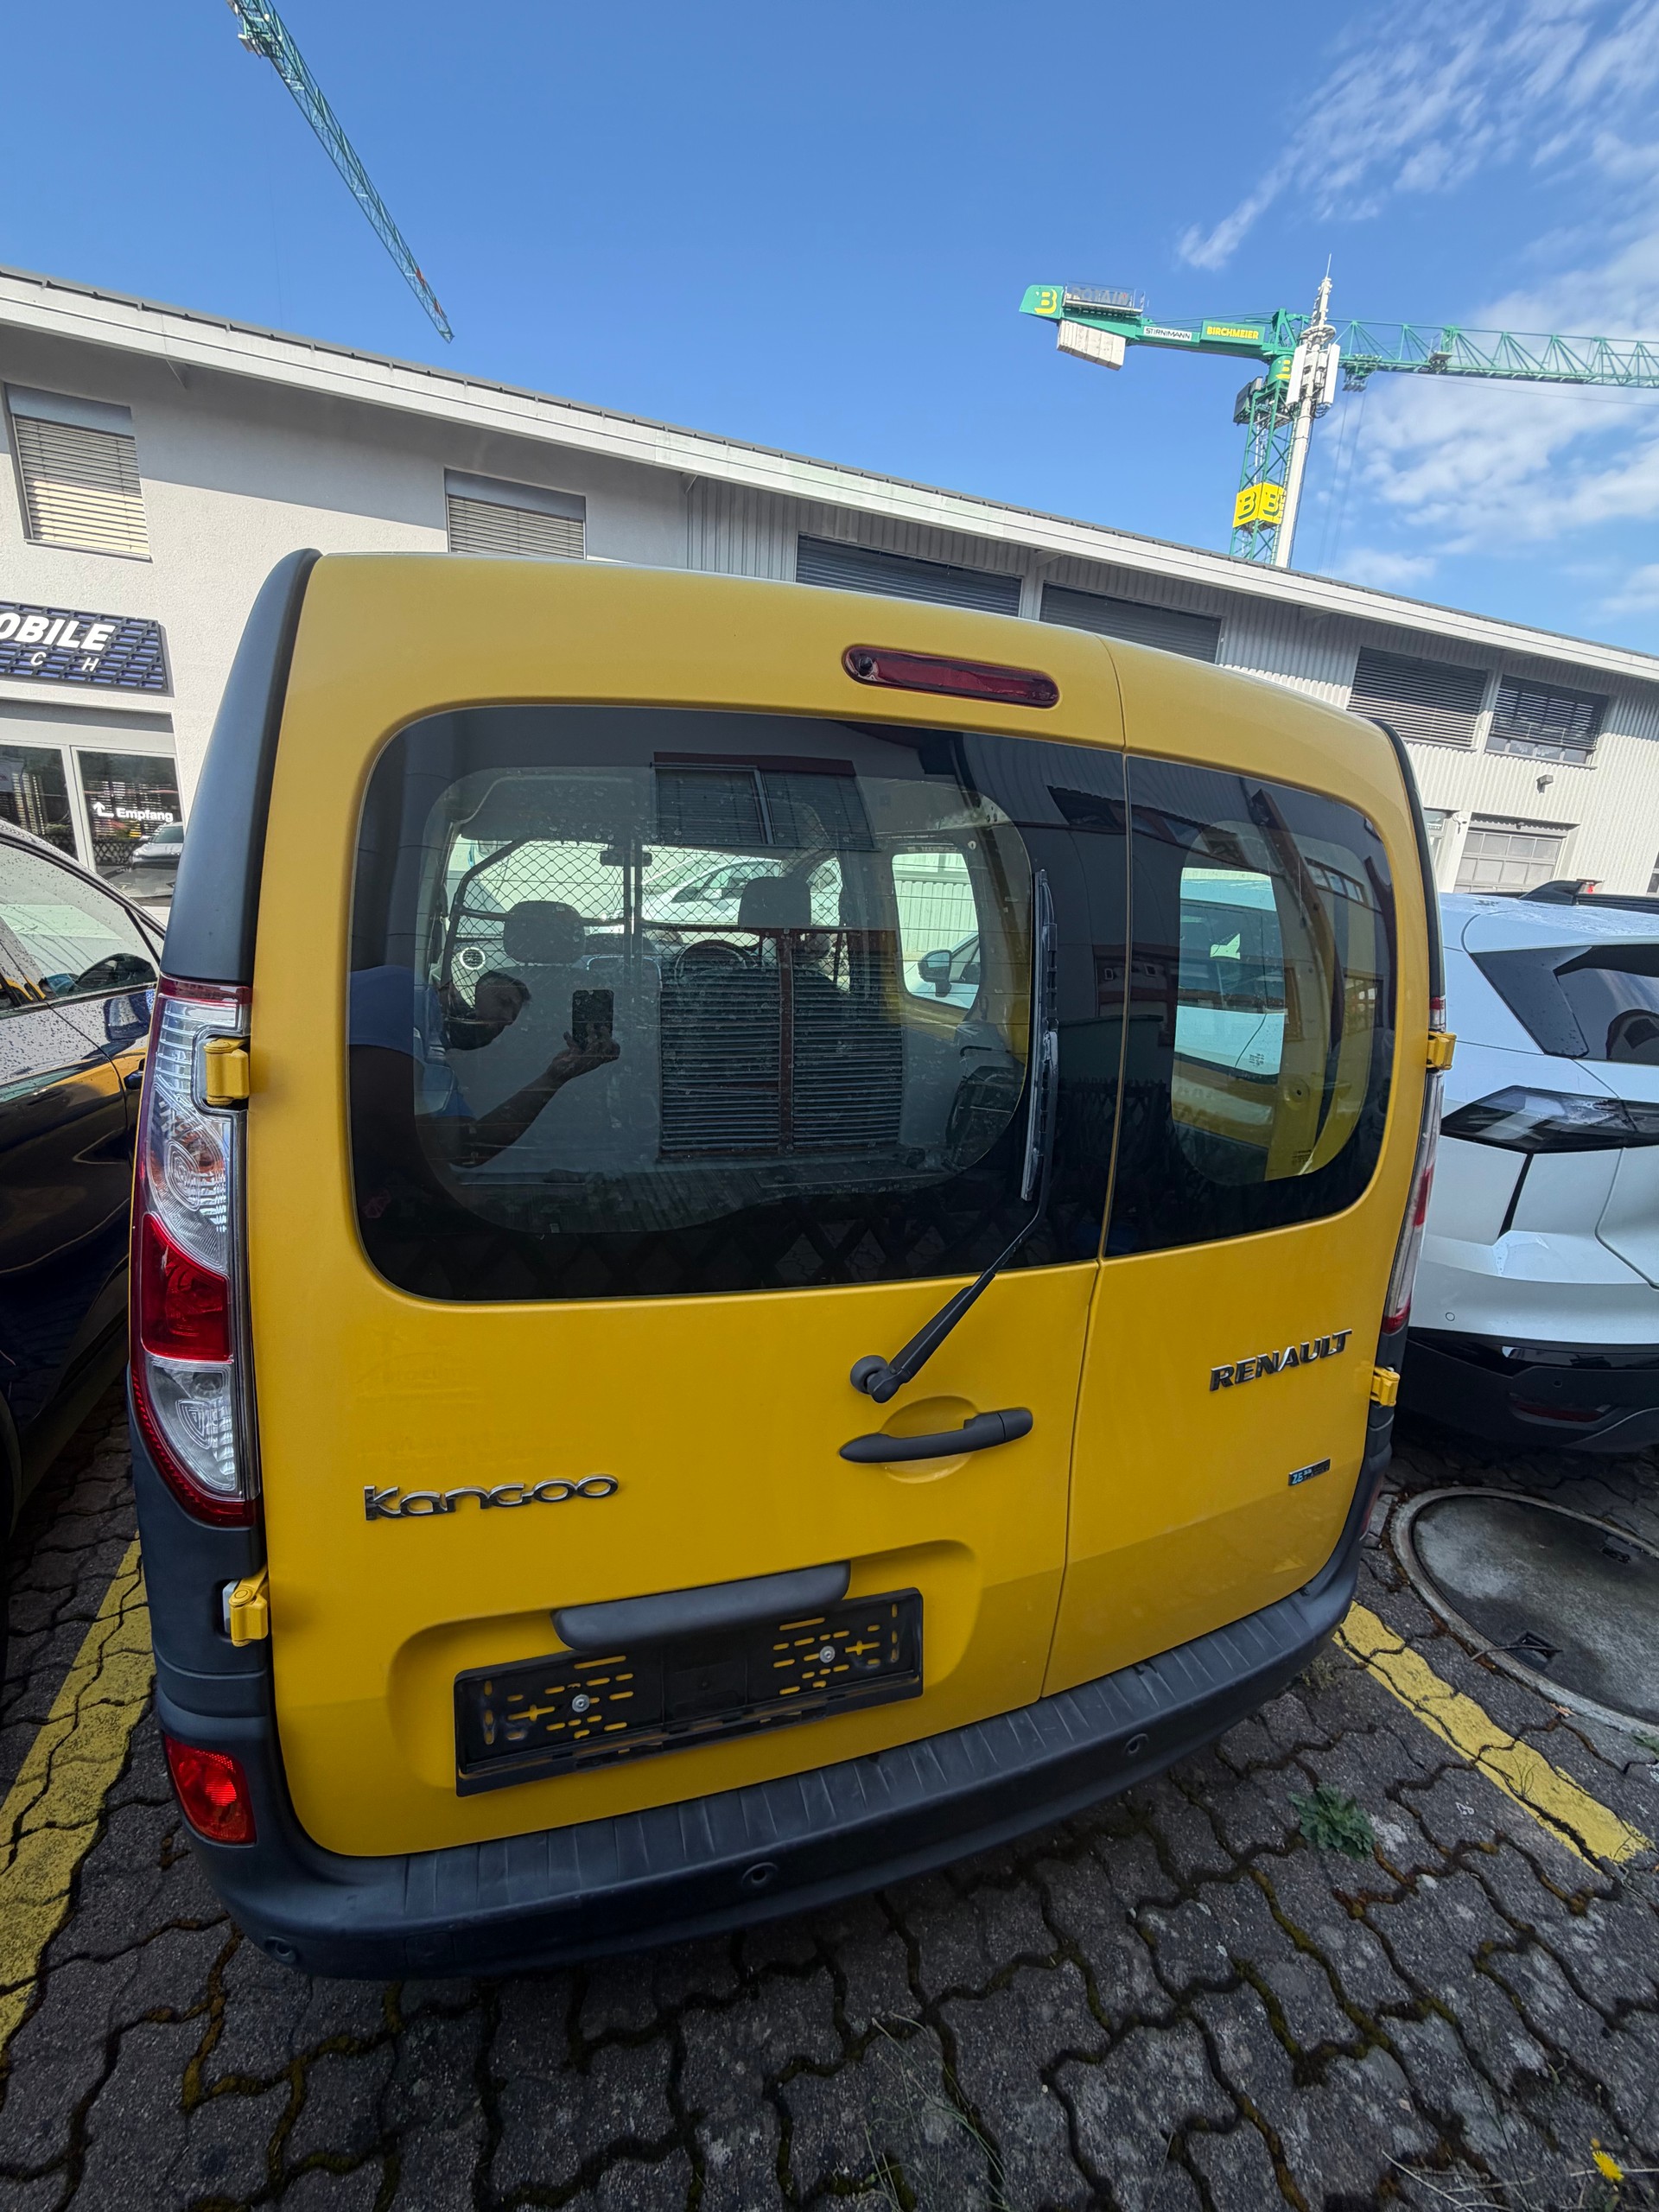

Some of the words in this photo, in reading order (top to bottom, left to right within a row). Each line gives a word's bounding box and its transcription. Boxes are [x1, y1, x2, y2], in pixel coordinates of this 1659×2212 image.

[1145, 327, 1191, 340] STIRNIMANN
[1206, 326, 1259, 340] BIRCHMEIER
[116, 807, 174, 823] Empfang
[1210, 1328, 1353, 1391] RENAULT
[363, 1472, 620, 1522] Kangoo
